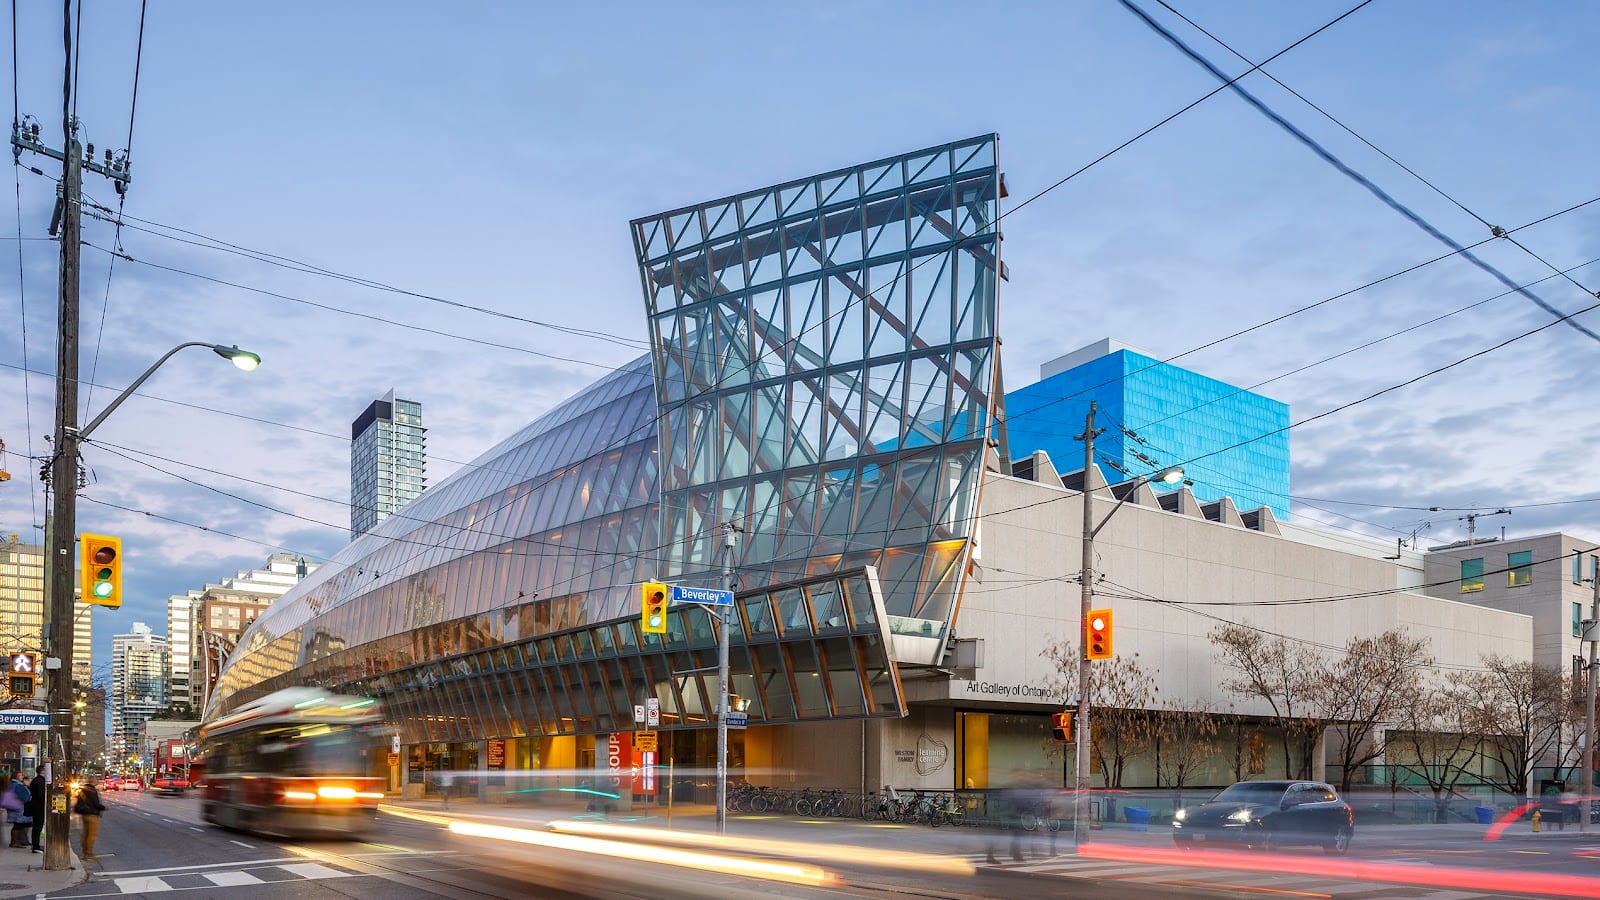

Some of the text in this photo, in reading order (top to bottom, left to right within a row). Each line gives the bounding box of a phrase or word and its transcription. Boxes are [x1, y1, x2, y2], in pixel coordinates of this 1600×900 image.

[681, 588, 720, 605] Beverley
[966, 681, 1052, 698] Art Gallery of Ontario
[0, 715, 36, 724] Beverley
[609, 731, 620, 787] GROUP
